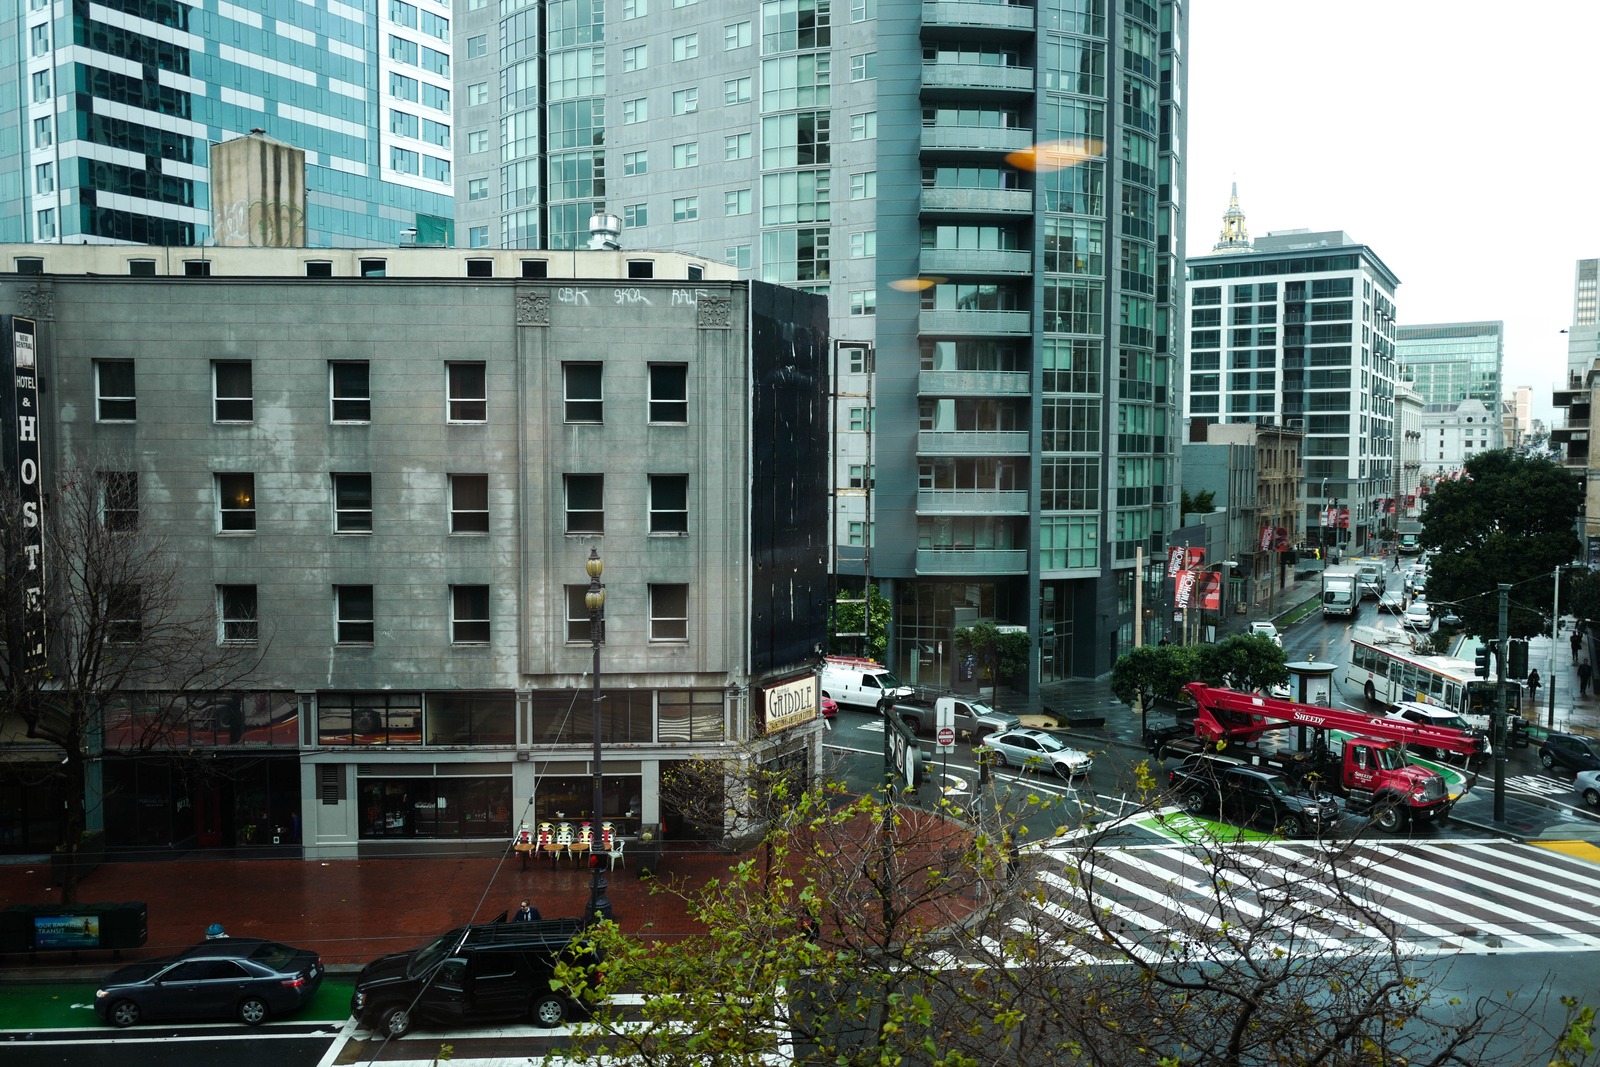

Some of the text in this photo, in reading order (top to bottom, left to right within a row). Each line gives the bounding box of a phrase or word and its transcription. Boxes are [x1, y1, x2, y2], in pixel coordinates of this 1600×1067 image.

[19, 334, 28, 342] NEW
[16, 341, 33, 350] CENTRAL
[16, 375, 36, 389] HOTEL
[22, 397, 31, 407] &
[1178, 570, 1196, 609] SYMPHONY
[769, 685, 813, 718] GRIDDLE
[1293, 711, 1326, 725] SHEEDY
